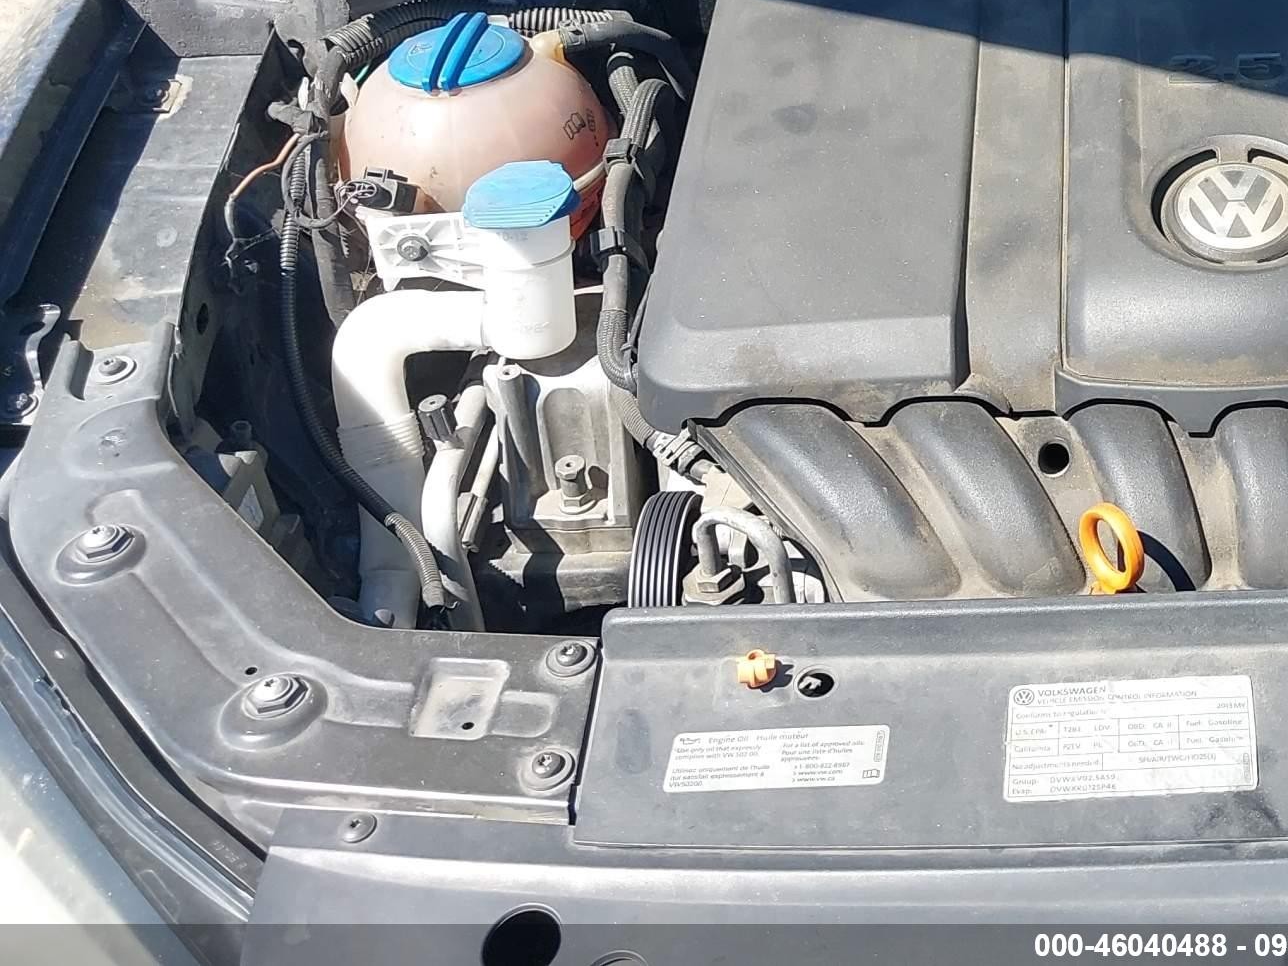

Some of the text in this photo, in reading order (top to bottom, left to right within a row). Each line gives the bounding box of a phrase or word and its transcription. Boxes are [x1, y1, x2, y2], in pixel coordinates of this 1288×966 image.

[1037, 686, 1106, 697] VOLKSWAGEN
[1037, 696, 1066, 704] VEHICLE
[1107, 692, 1140, 700] CONTROL
[1143, 690, 1197, 699] INFORMATION
